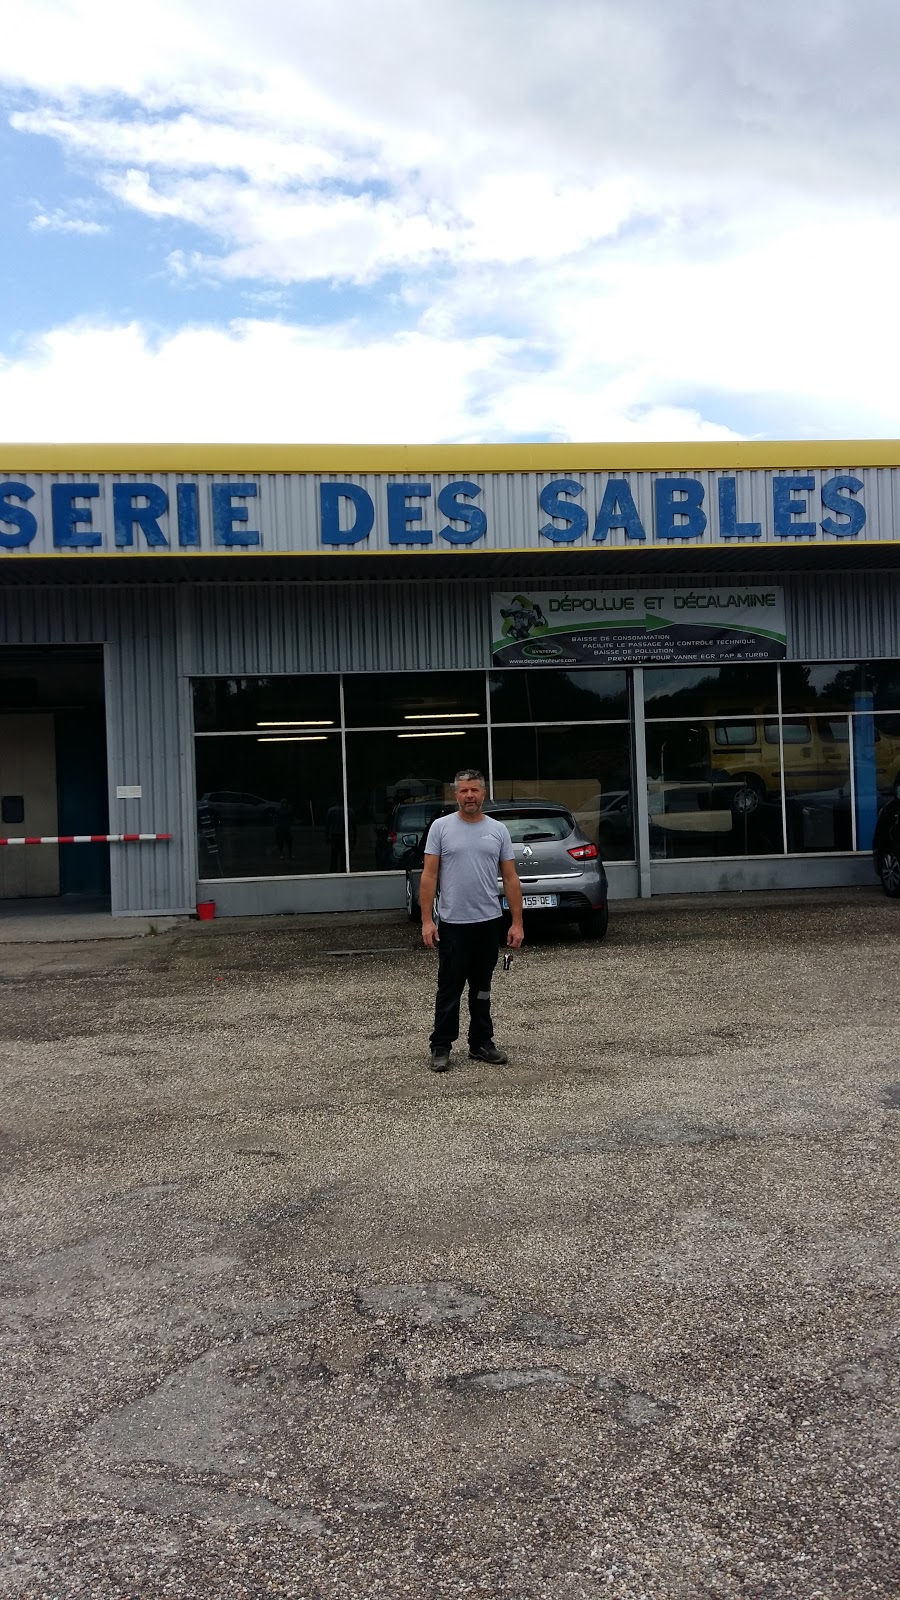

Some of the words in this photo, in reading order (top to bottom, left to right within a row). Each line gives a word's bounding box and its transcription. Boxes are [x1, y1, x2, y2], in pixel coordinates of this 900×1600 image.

[0, 481, 259, 547] SERIE
[320, 480, 487, 544] DES
[539, 475, 867, 542] SABLES
[549, 595, 635, 612] DÉPOLLUE
[644, 596, 664, 609] ET
[673, 591, 776, 609] DÉCALAMINE
